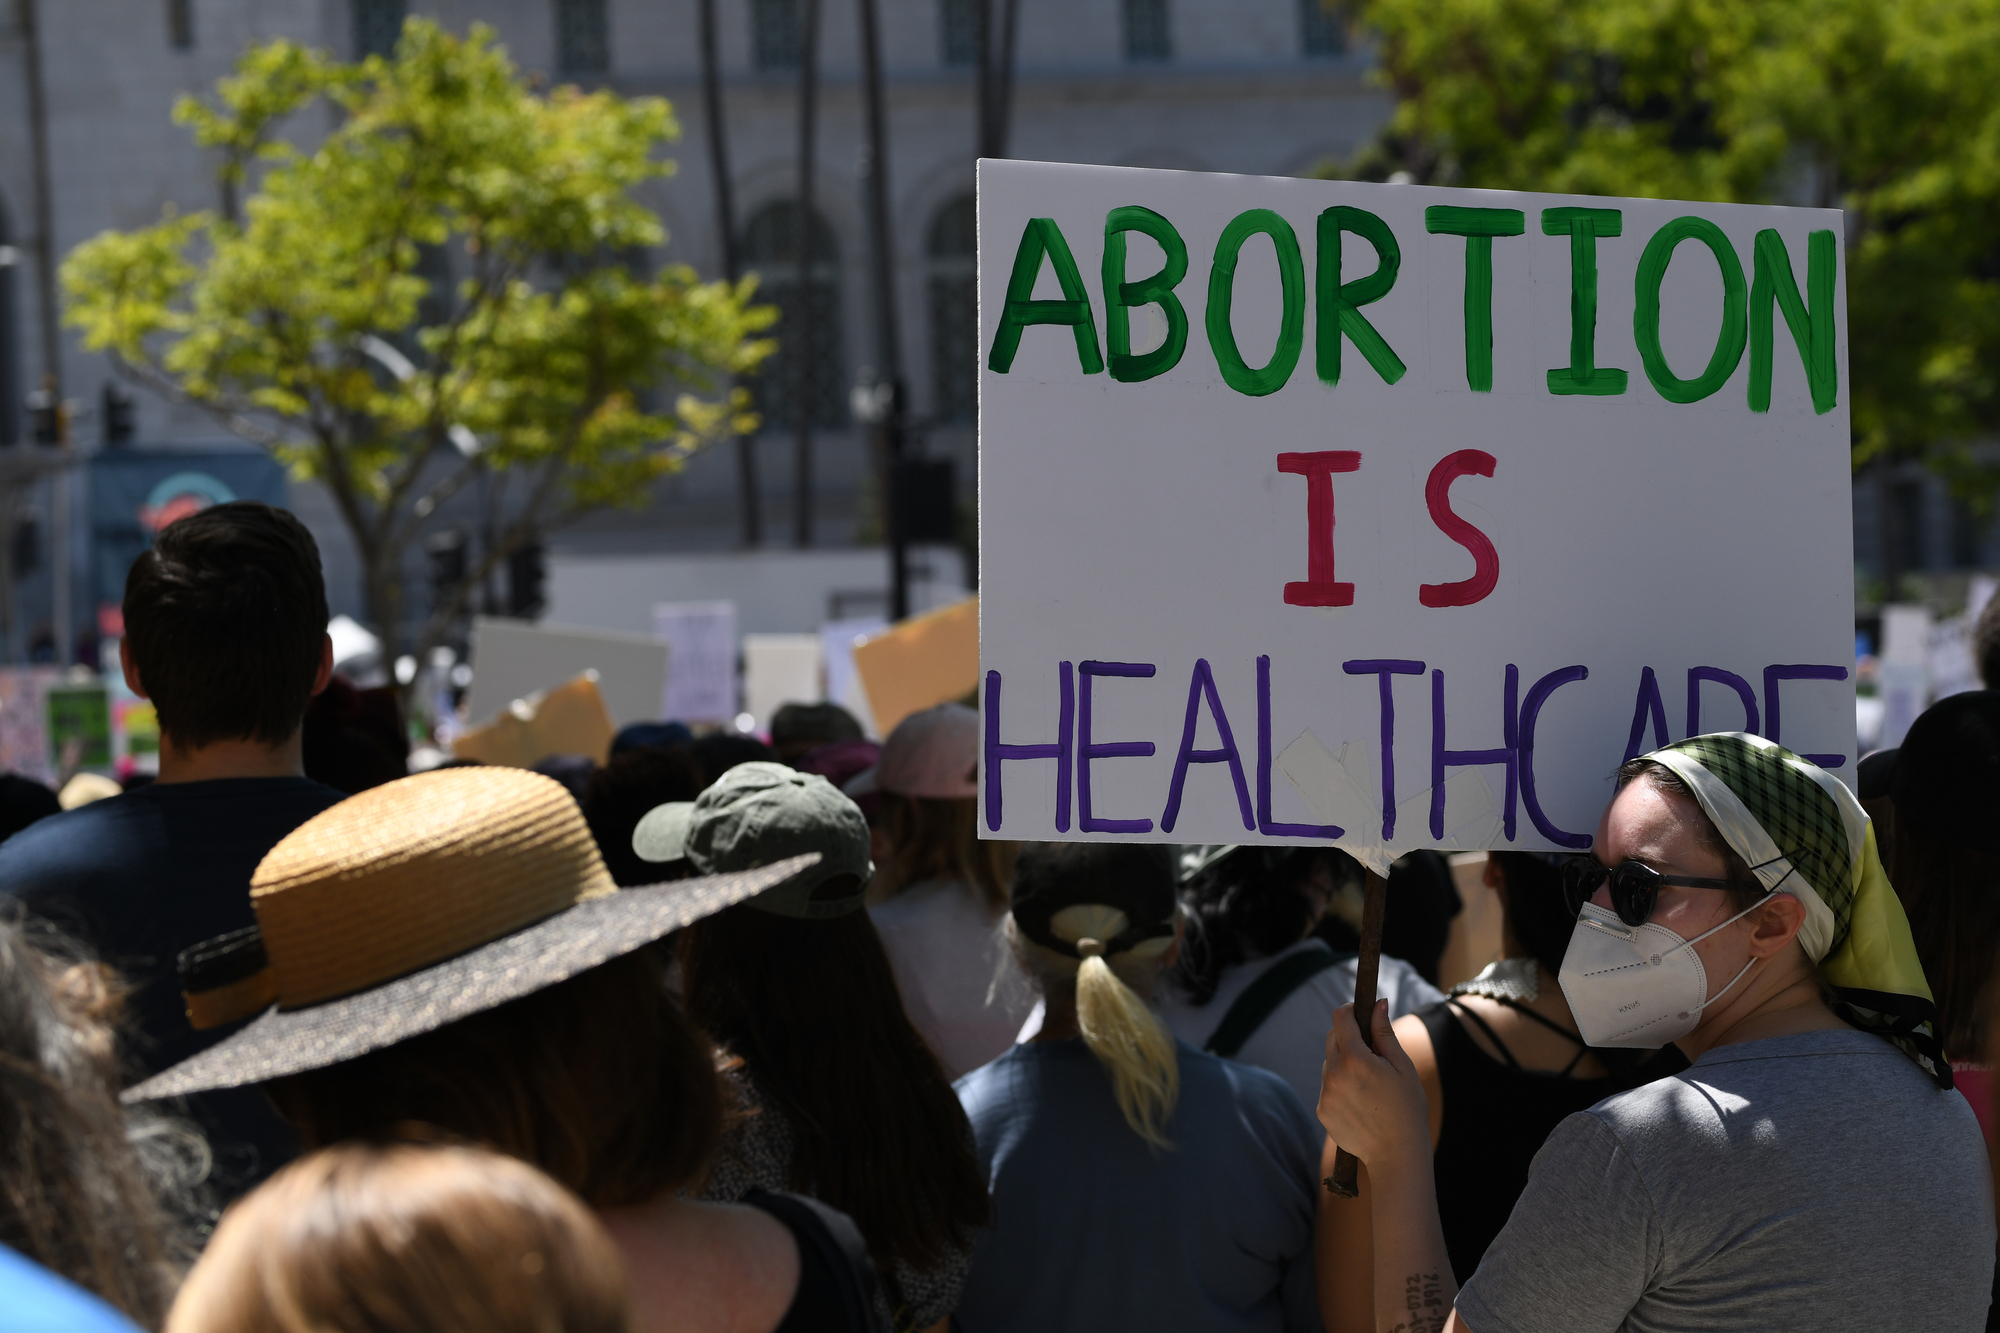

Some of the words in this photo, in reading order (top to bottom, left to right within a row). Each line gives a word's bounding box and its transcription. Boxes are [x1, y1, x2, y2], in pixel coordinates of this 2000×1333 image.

[988, 206, 1839, 415] ABORTION
[1277, 449, 1499, 607] IS
[1618, 1000, 1641, 1013] KN95
